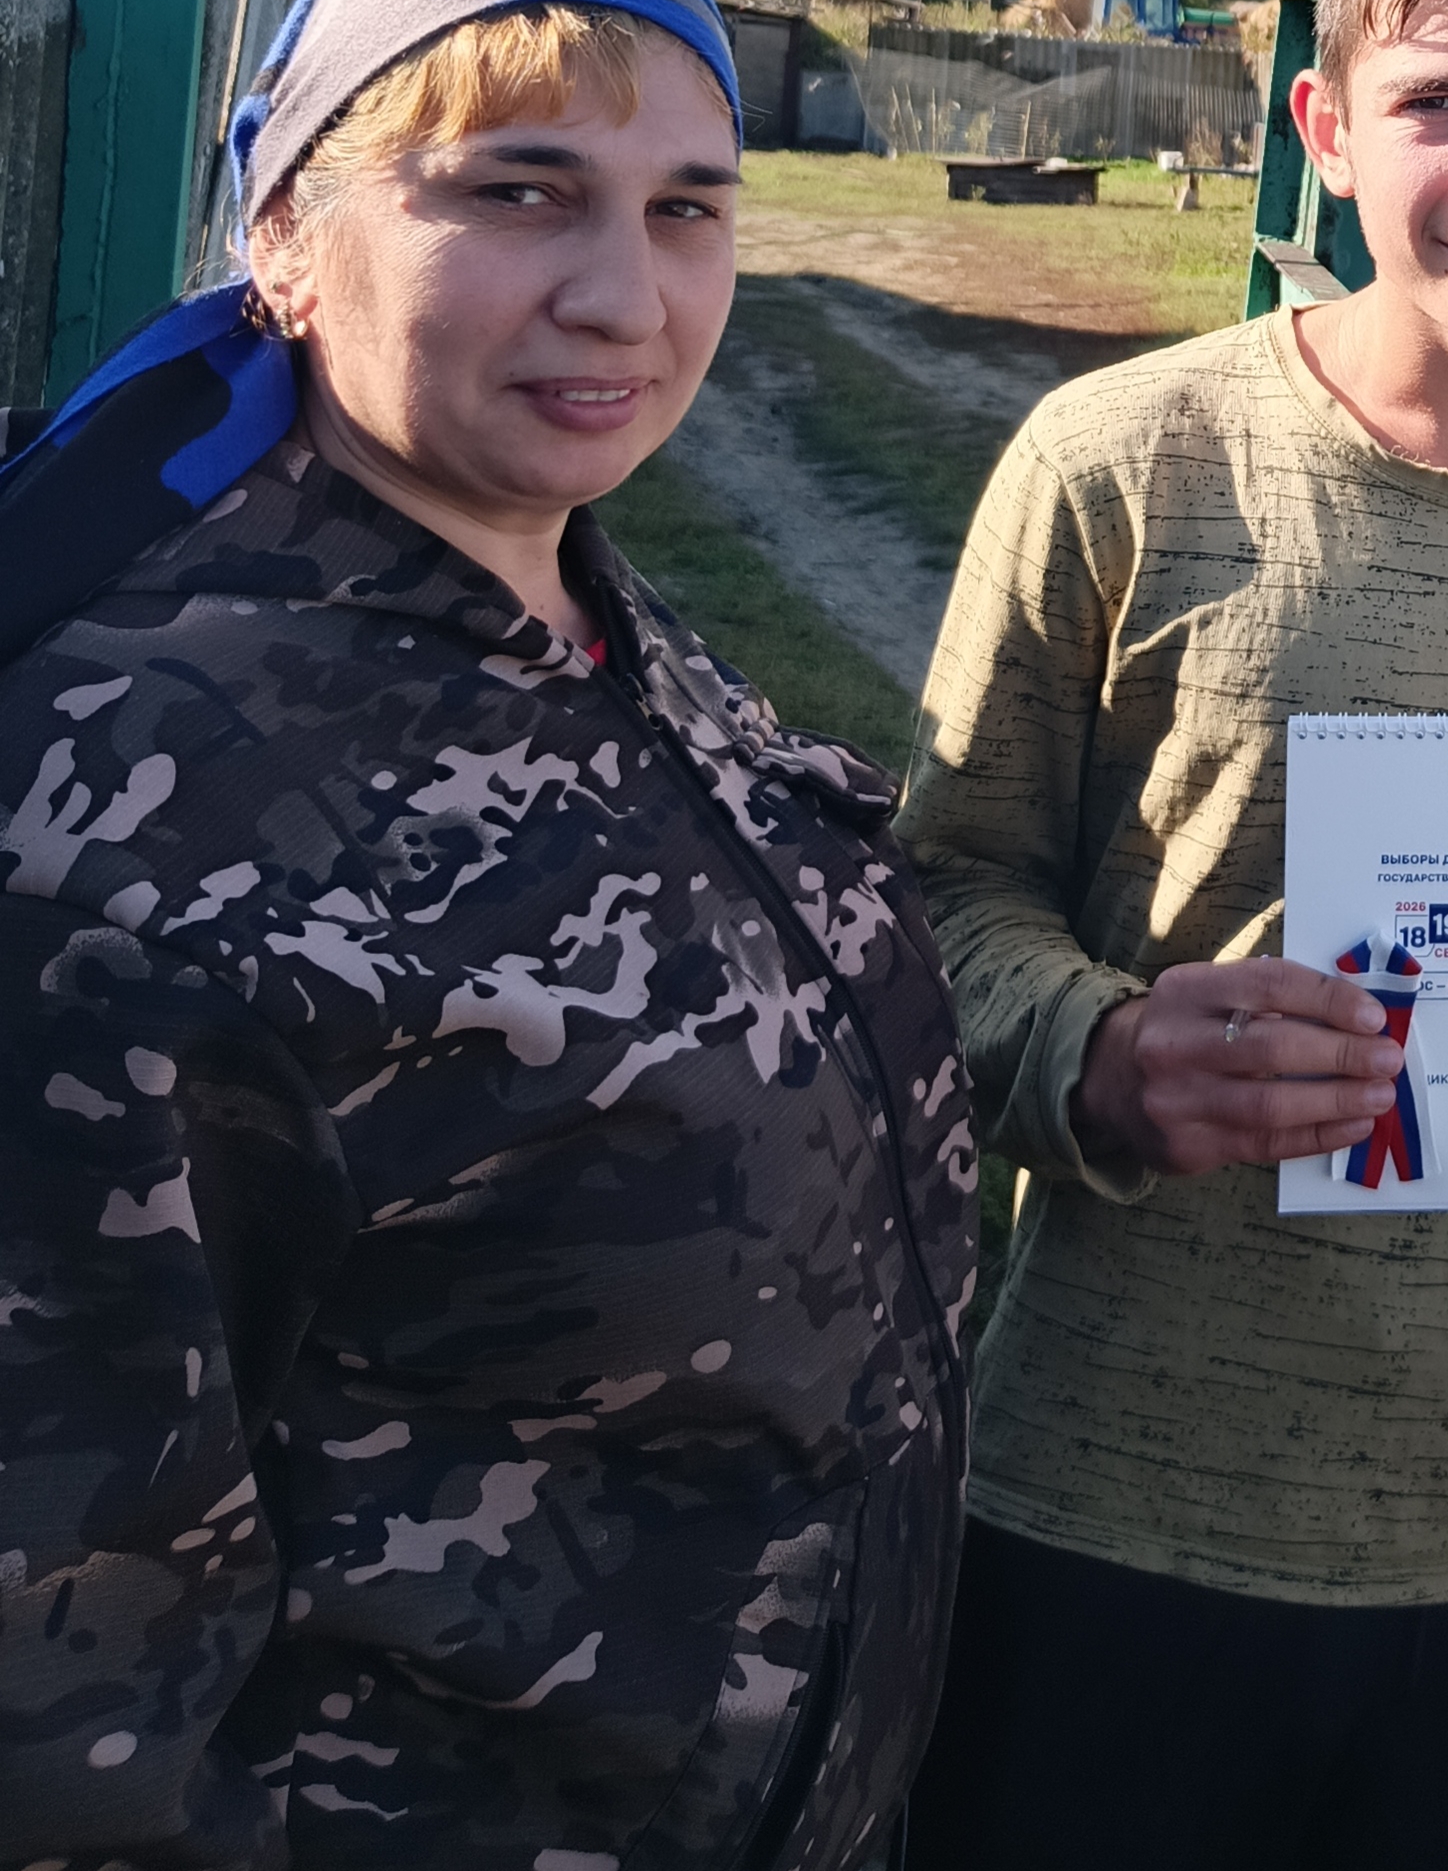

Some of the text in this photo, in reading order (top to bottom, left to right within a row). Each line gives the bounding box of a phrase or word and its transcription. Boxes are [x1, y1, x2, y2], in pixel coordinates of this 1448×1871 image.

[1381, 854, 1440, 865] ВЫБОРЫ
[1395, 901, 1426, 912] 2026
[1400, 926, 1426, 948] 18
